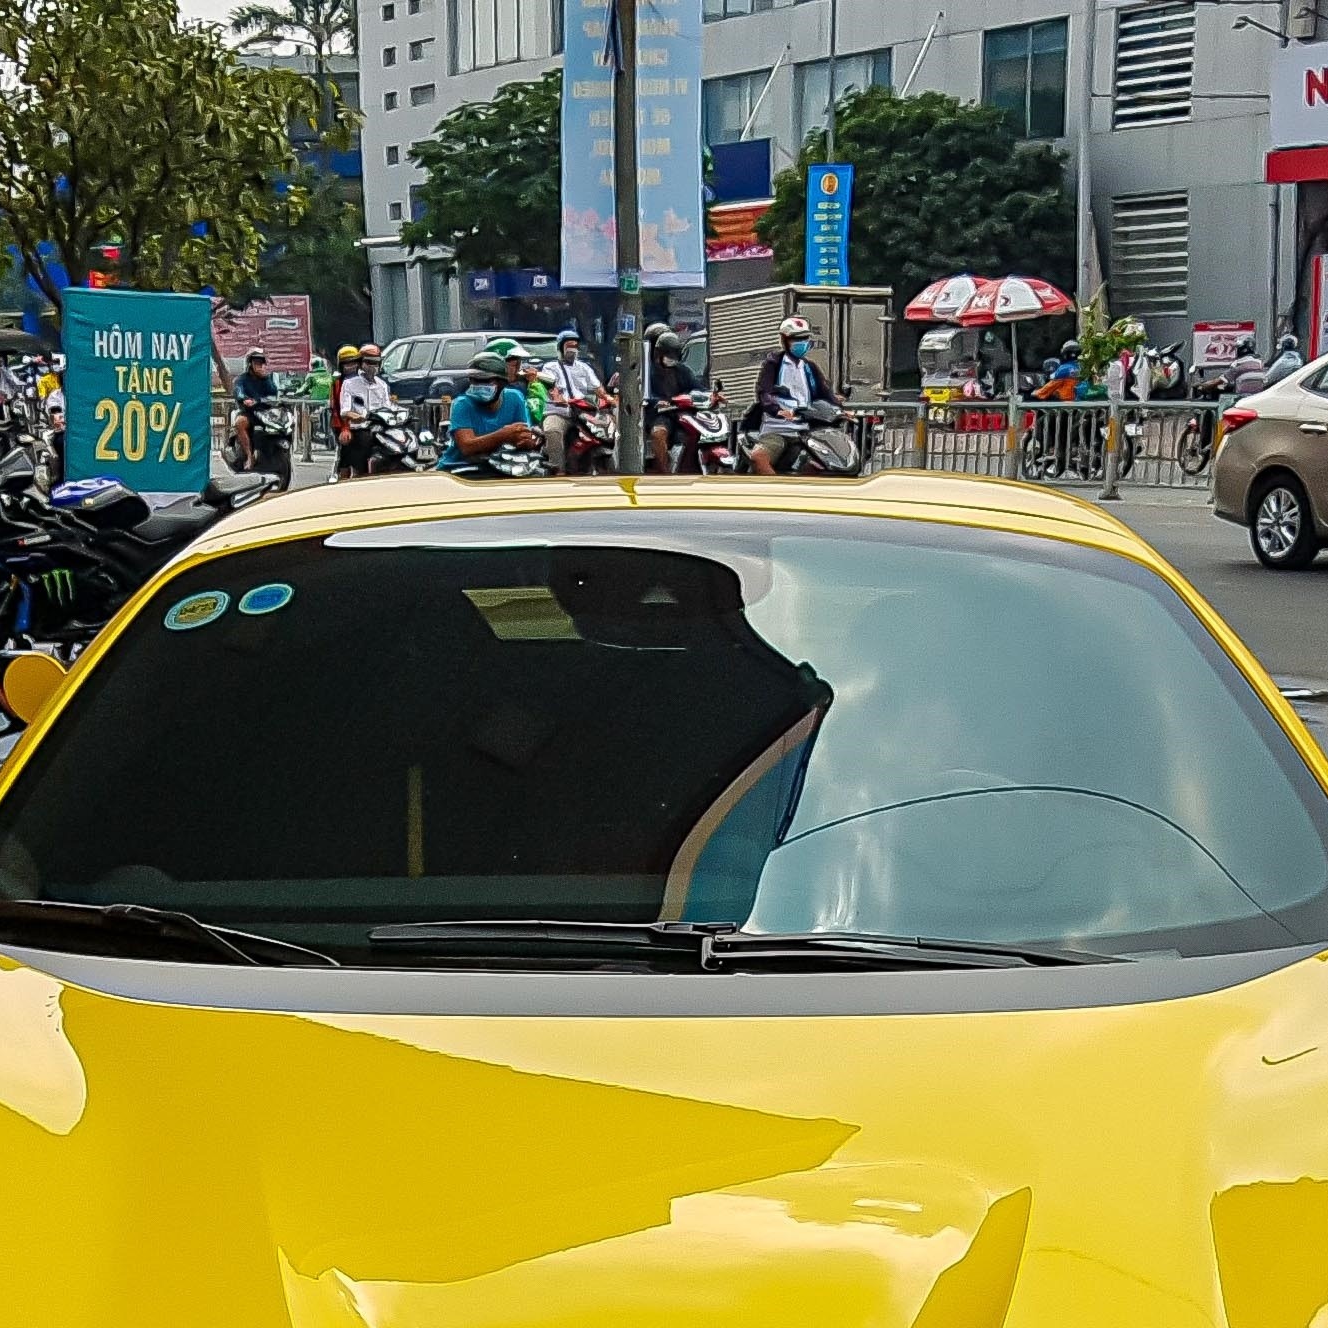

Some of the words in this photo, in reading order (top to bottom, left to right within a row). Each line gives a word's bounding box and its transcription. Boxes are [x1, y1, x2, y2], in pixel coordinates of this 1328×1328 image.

[94, 324, 143, 359] HÔM
[151, 332, 193, 361] NAY
[115, 360, 174, 400] TẶNG
[94, 398, 191, 463] 20%
